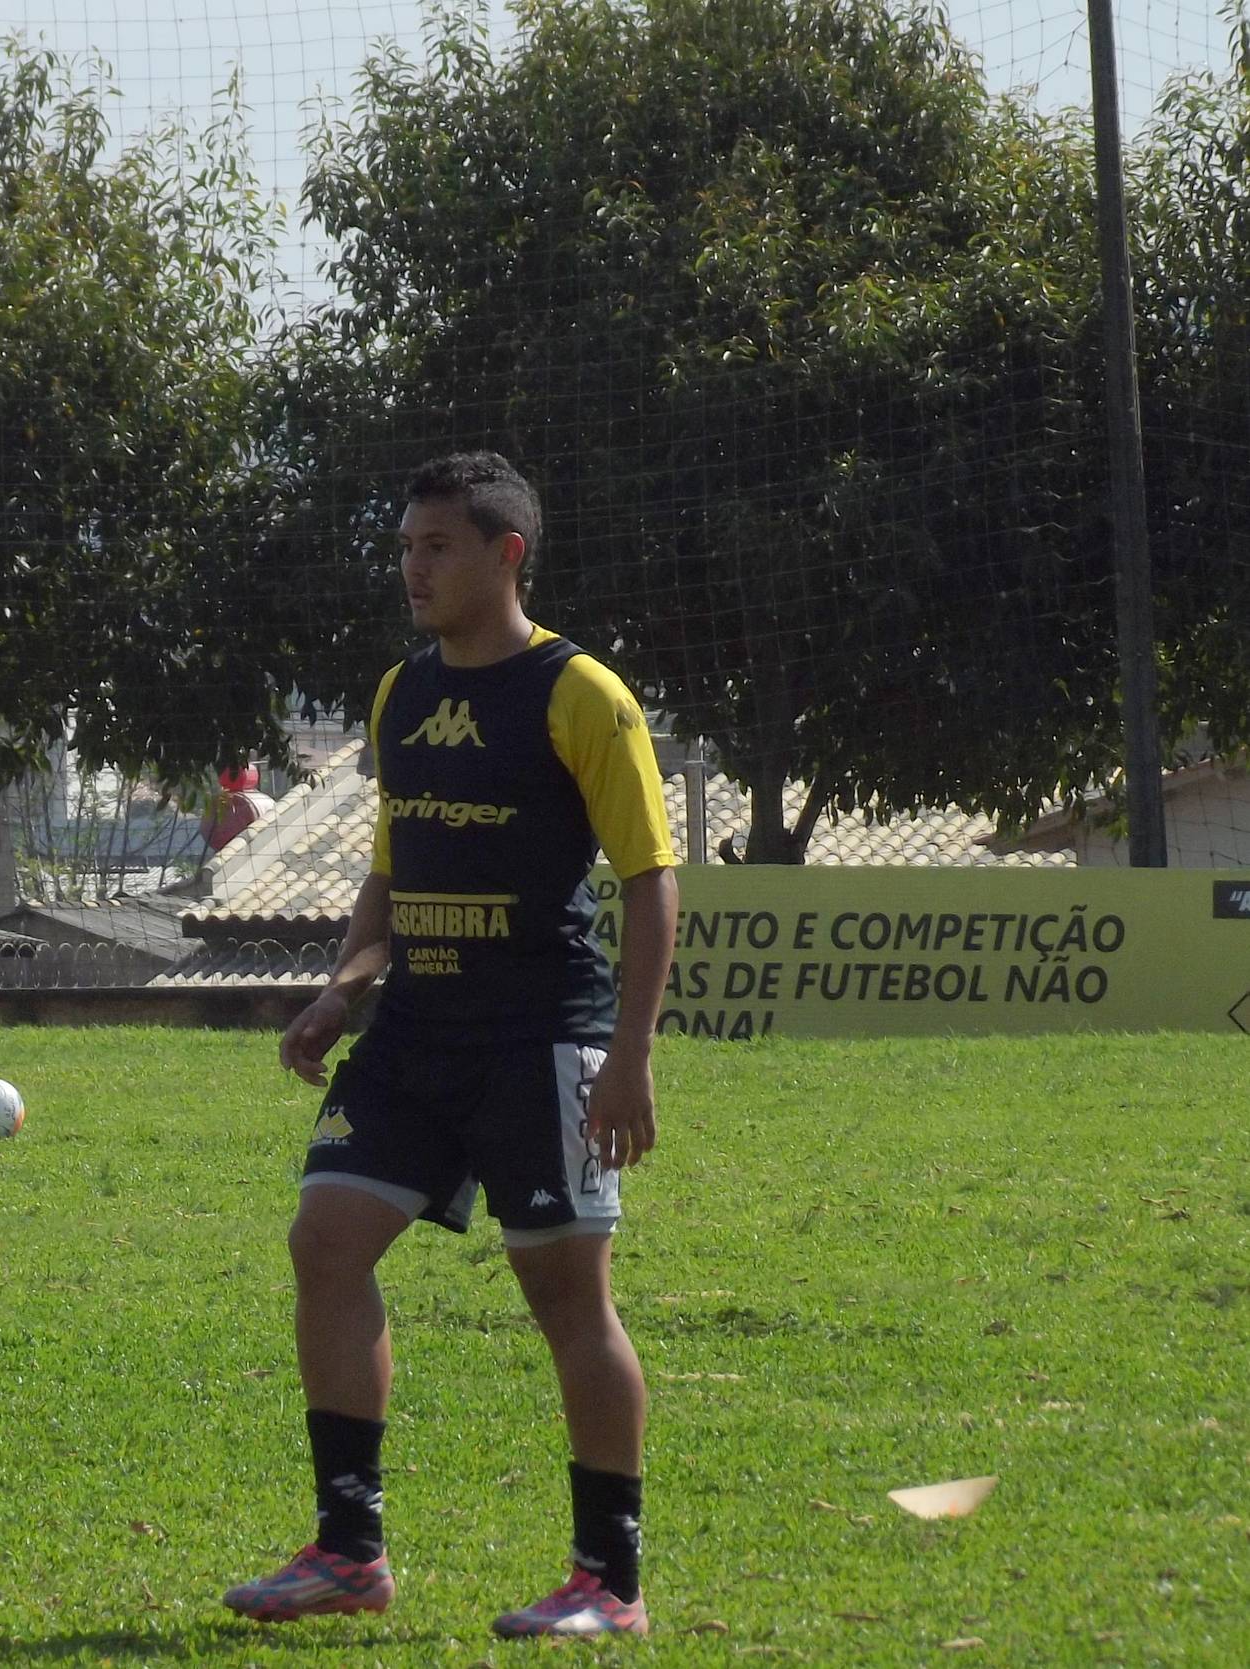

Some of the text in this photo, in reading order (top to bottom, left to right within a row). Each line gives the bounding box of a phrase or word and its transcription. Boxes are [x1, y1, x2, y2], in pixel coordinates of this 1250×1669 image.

[793, 912, 818, 949] E
[830, 904, 1126, 963] COMPETIÇÃO
[723, 962, 783, 1000] DE
[794, 962, 989, 1001] FUTEBOL
[1004, 954, 1109, 1004] NÃO
